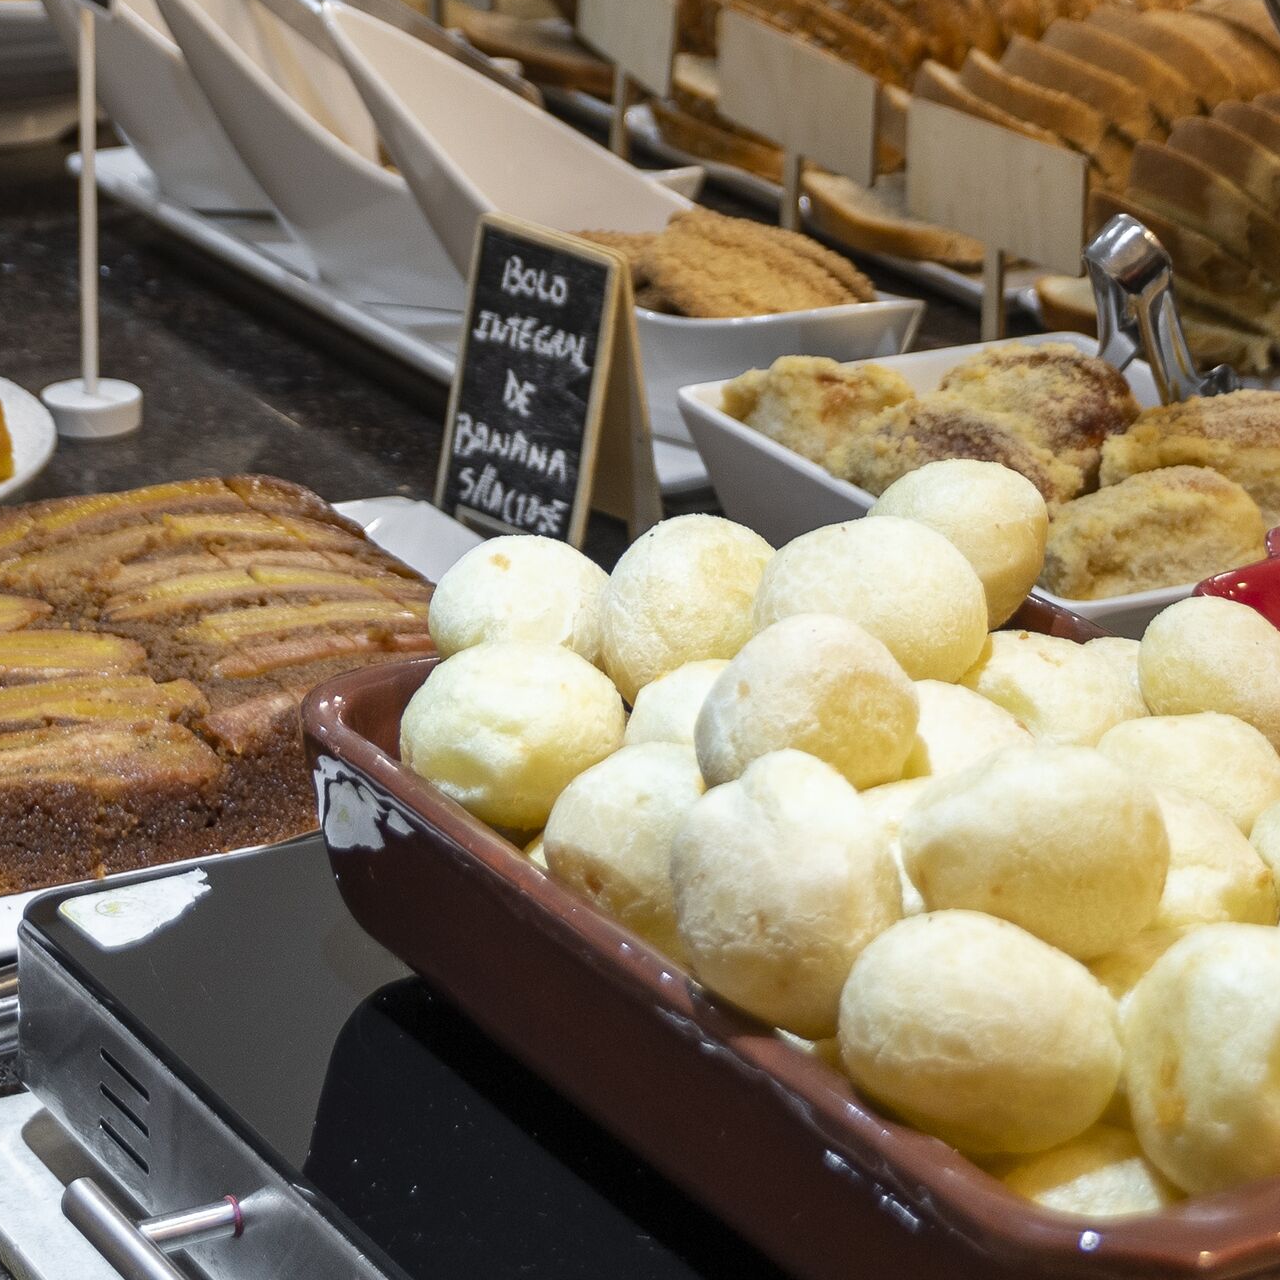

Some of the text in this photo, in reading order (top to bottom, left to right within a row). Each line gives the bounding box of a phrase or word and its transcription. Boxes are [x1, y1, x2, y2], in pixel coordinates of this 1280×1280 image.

[500, 254, 569, 307] BOLO
[473, 310, 589, 372] INTEGRAL
[503, 368, 538, 418] DE
[454, 410, 568, 484] BANANA
